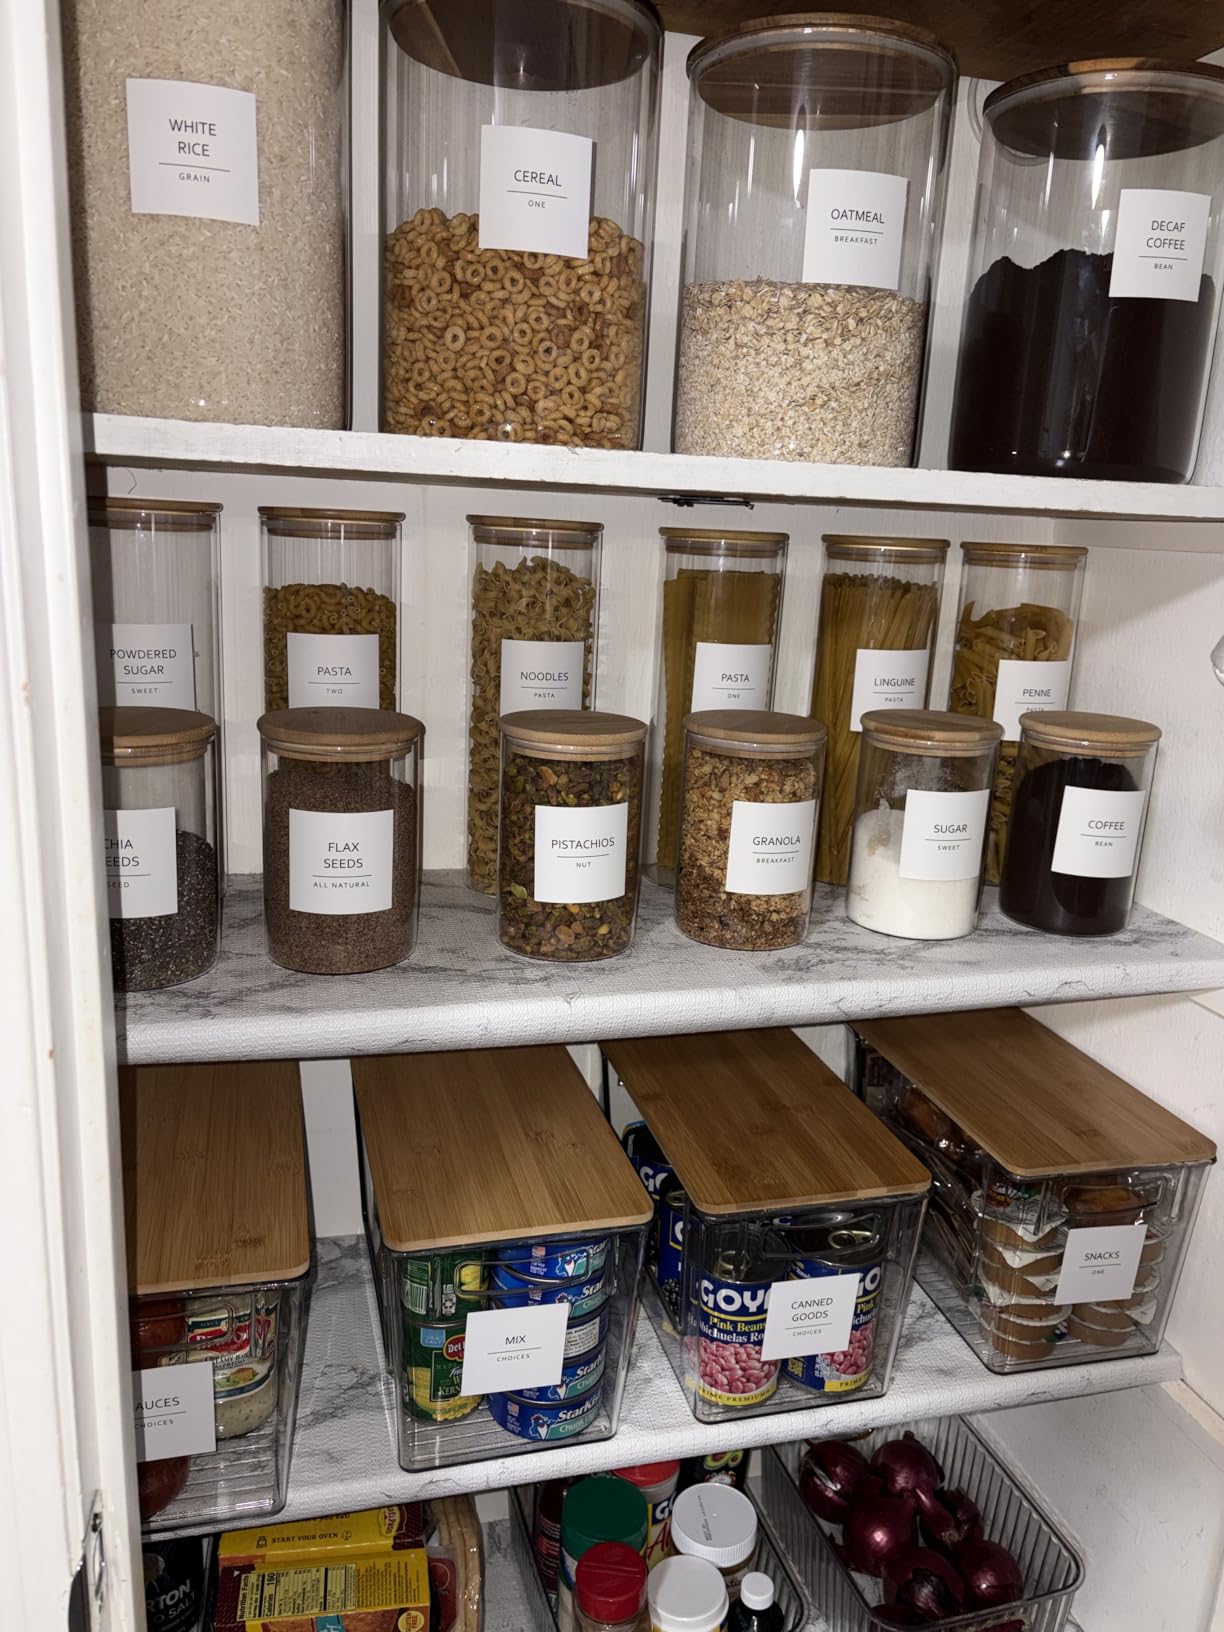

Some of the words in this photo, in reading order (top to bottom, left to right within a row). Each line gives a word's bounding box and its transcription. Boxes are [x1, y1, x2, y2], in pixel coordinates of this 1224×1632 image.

[168, 118, 217, 136] WHITE
[177, 140, 210, 157] RICE
[178, 172, 211, 183] GRAIN
[513, 169, 562, 187] CEREAL
[527, 199, 546, 209] ONE
[830, 208, 885, 225] OATMEAL
[1151, 219, 1186, 233] DECAF
[834, 235, 878, 246] BREAKFAST
[1146, 237, 1186, 251] COFFEE
[1153, 262, 1174, 271] BEAN
[110, 648, 177, 660] POWDERED
[123, 664, 165, 676] SUGAR
[317, 666, 352, 677] PASTA
[520, 671, 569, 682] NOODLES
[721, 673, 750, 684] PASTA
[874, 677, 916, 689] LINGUINE
[131, 687, 159, 695] SWEET
[1022, 688, 1052, 697] PENNE
[933, 823, 968, 834] SUGAR
[1087, 820, 1126, 832] COFFEE
[551, 836, 616, 850] PISTACHIOS
[752, 835, 801, 847] GRANOLA
[328, 842, 360, 853] FLAX
[105, 856, 140, 868] EEDS
[323, 858, 363, 869] SEEDS
[575, 861, 592, 869] NUT
[756, 857, 795, 865] BREAKFAST
[313, 881, 329, 889] ALL
[331, 881, 370, 889] NATURAL
[1083, 1250, 1121, 1262] SNACKS
[582, 1280, 603, 1297] Star
[791, 1297, 834, 1310] CANNED
[792, 1310, 829, 1322] GOODS
[710, 1315, 733, 1331] Pink
[792, 1328, 822, 1337] CHOICES
[505, 1335, 527, 1345] MIX
[496, 1353, 531, 1362] CHOICES
[135, 1397, 180, 1410] AUCES
[272, 1535, 295, 1544] START
[297, 1534, 317, 1542] YOUR
[319, 1532, 338, 1541] OVEN
[147, 1580, 191, 1611] RTON
